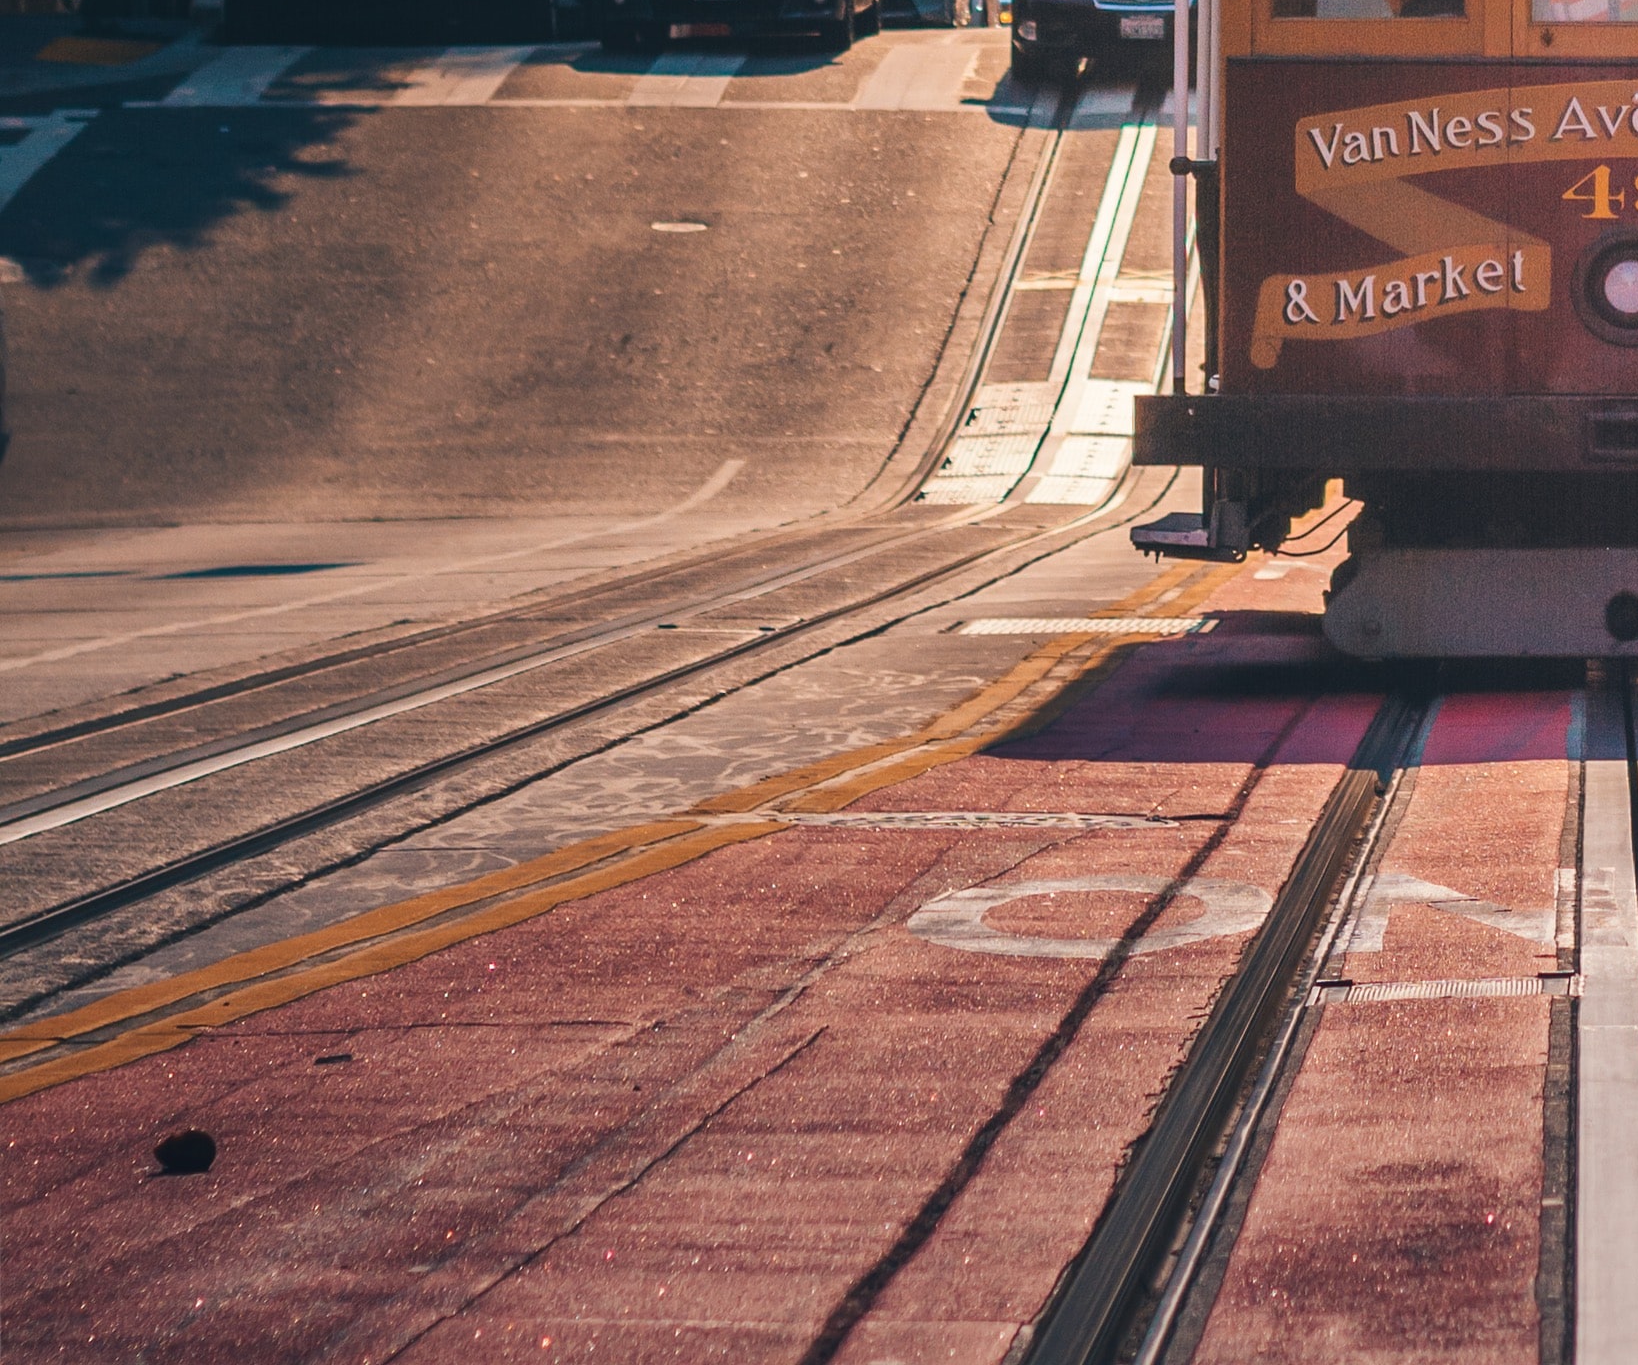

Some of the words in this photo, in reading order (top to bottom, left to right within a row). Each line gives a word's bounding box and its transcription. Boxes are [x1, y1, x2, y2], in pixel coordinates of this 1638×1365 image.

[1307, 122, 1401, 169] Van
[1406, 106, 1537, 155] Ness
[1284, 279, 1321, 324] &
[1335, 249, 1528, 322] Market
